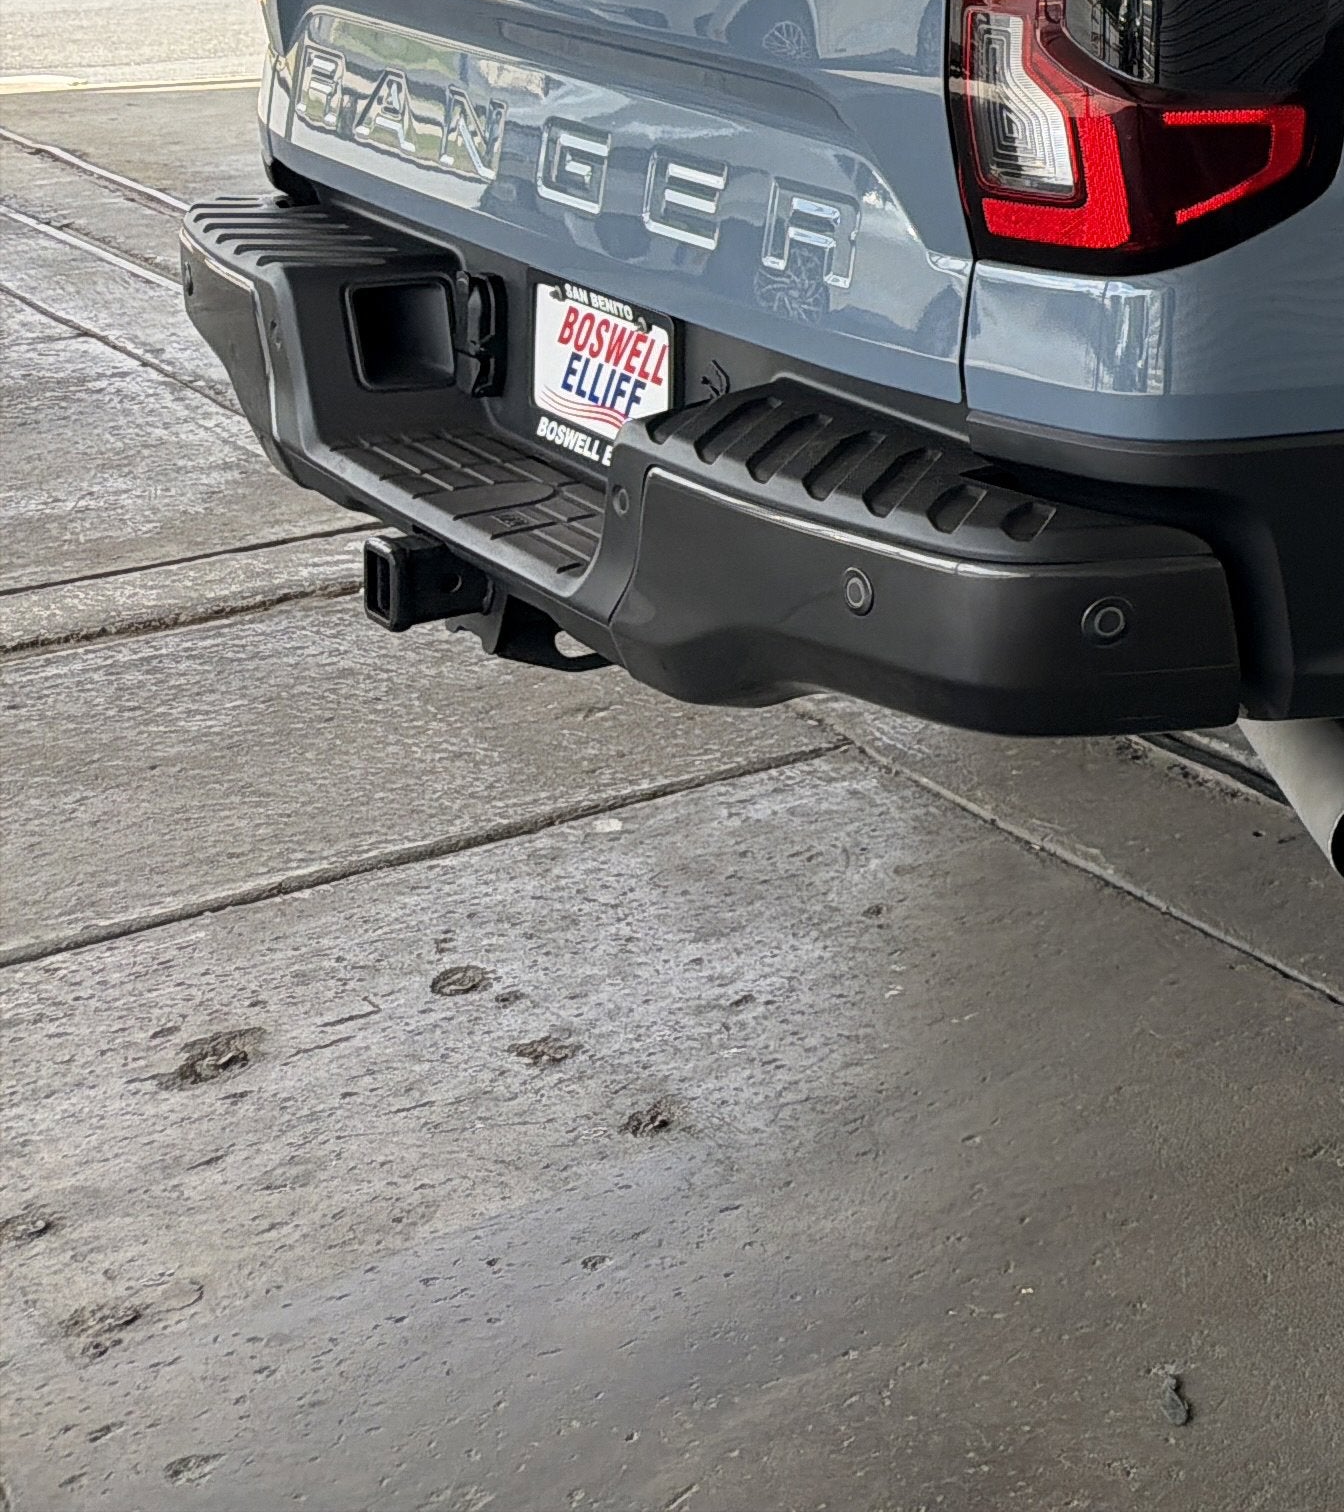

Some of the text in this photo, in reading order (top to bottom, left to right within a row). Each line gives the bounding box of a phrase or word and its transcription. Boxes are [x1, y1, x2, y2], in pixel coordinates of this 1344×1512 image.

[296, 44, 860, 289] RANGER
[565, 283, 633, 320] SAN BENITO
[557, 305, 669, 387] BOSWELL
[561, 351, 647, 419] ELLIFF
[536, 416, 600, 462] BOSWELL
